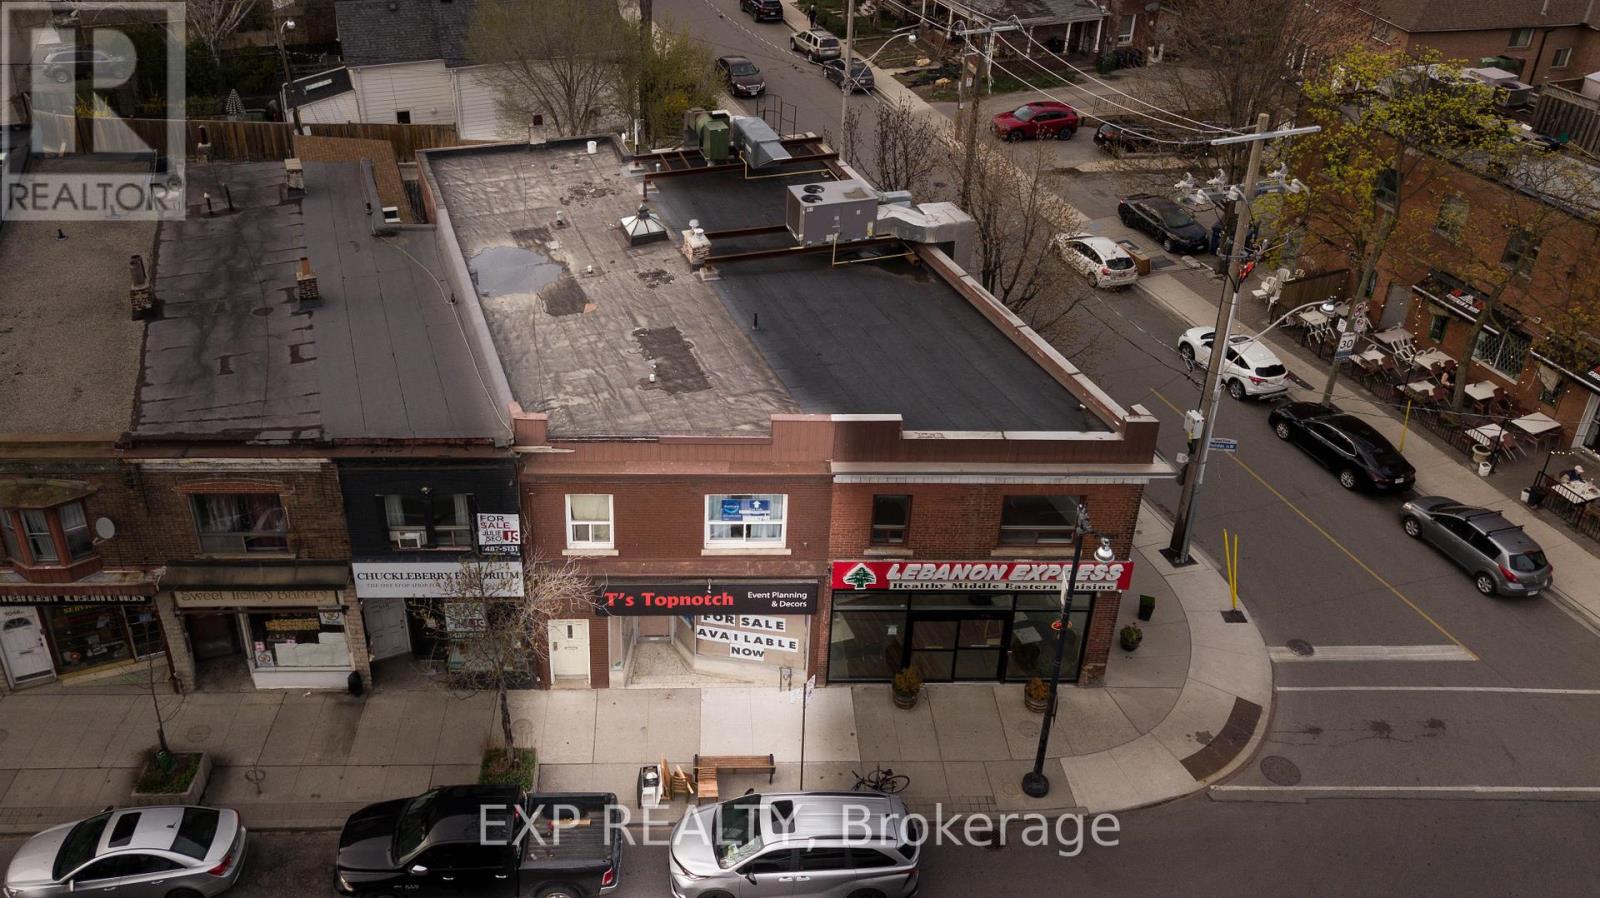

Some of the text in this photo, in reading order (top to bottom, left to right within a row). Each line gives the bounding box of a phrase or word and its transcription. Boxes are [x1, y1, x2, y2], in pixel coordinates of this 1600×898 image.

[1339, 339, 1354, 349] 30
[356, 571, 519, 581] CHUCKLEBERRY EMORIUM
[886, 563, 1124, 581] LEBANON EXPRESS
[893, 582, 946, 591] Healthy
[952, 582, 999, 590] Middle
[1005, 582, 1057, 590] Eastern
[604, 591, 735, 608] T's Topnotch
[747, 591, 808, 600] Event Planning
[703, 615, 785, 630] FOR SALE
[697, 628, 797, 649] AVAILABLE
[731, 646, 765, 657] NOW
